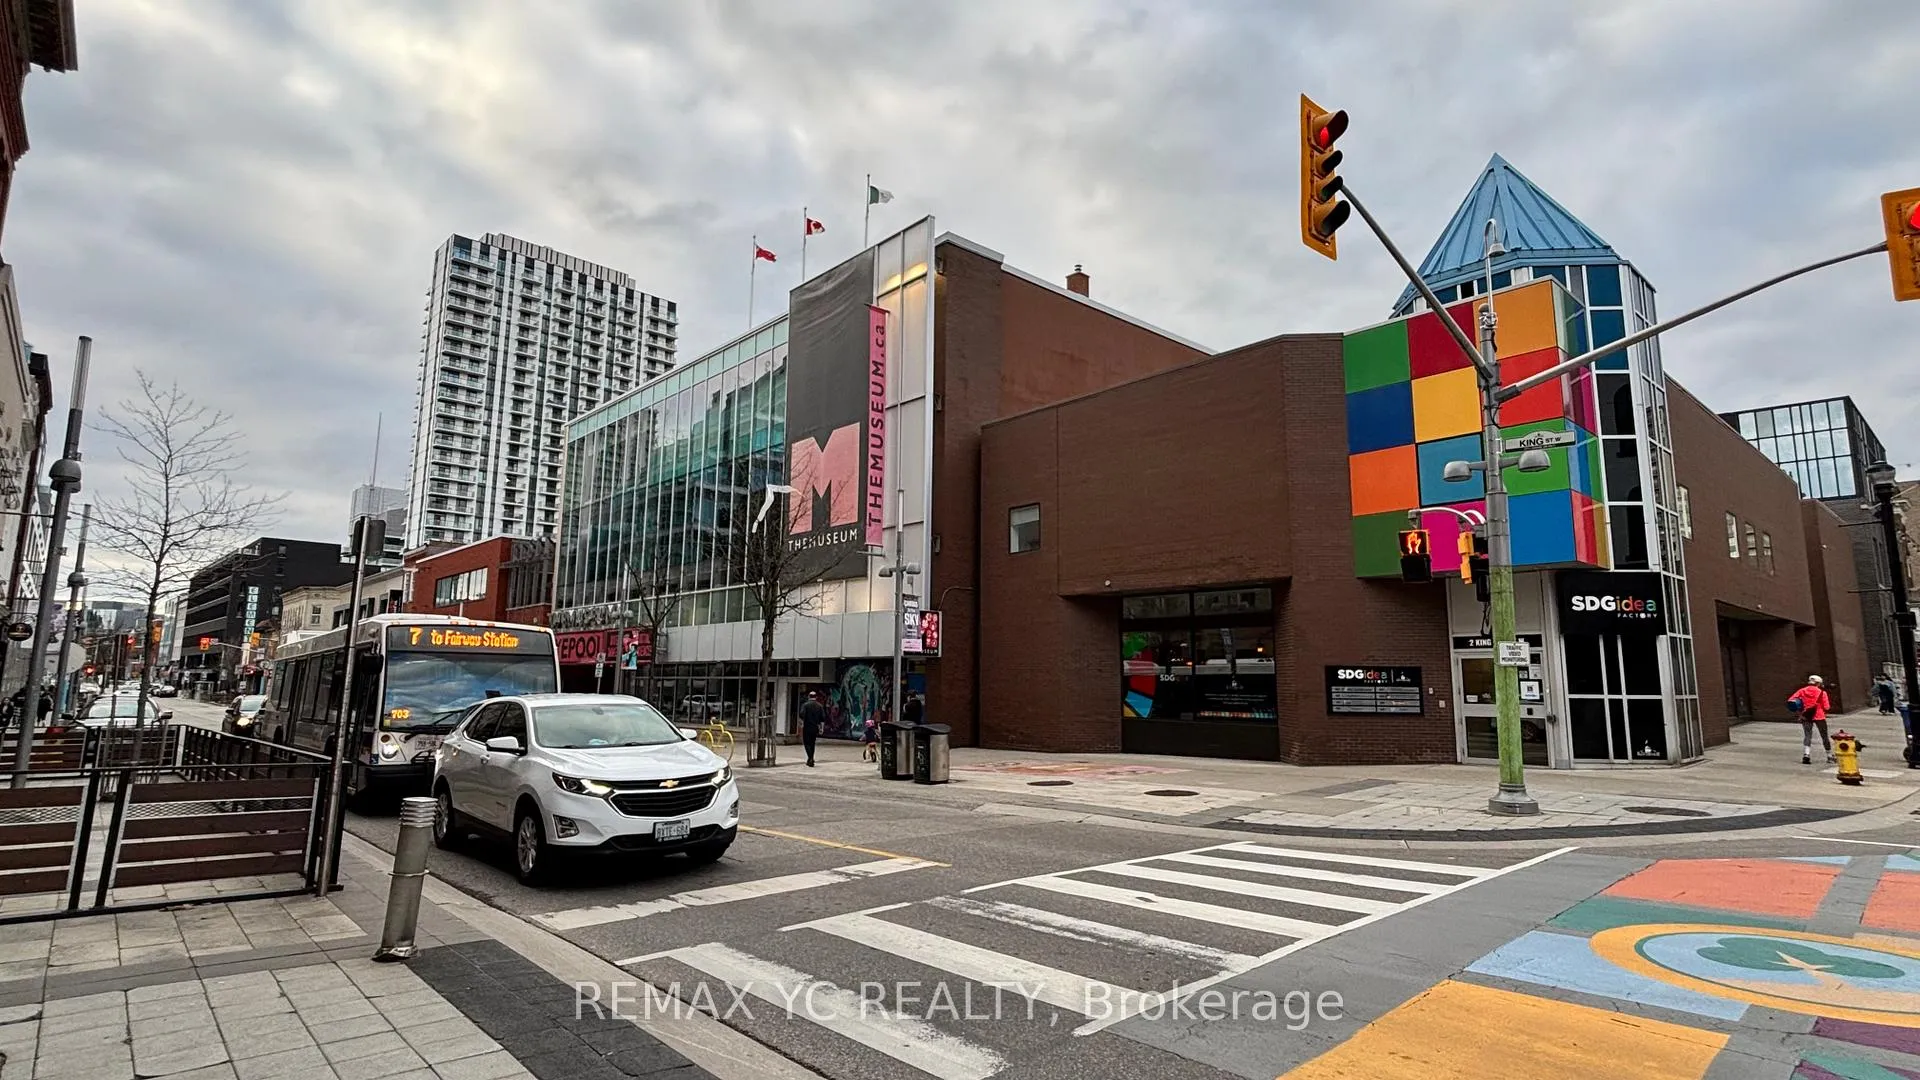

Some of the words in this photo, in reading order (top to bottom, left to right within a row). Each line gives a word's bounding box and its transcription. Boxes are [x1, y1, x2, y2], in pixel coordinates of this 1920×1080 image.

[868, 325, 885, 527] THEMUSEUM.ca
[1519, 437, 1544, 447] KING
[788, 528, 858, 551] THEMUSEUM
[904, 612, 919, 626] SKY
[409, 627, 423, 646] 7
[431, 629, 443, 645] to
[444, 630, 483, 647] Fairway
[483, 632, 520, 648] Station
[1469, 639, 1474, 647] 2
[391, 709, 410, 720] 703
